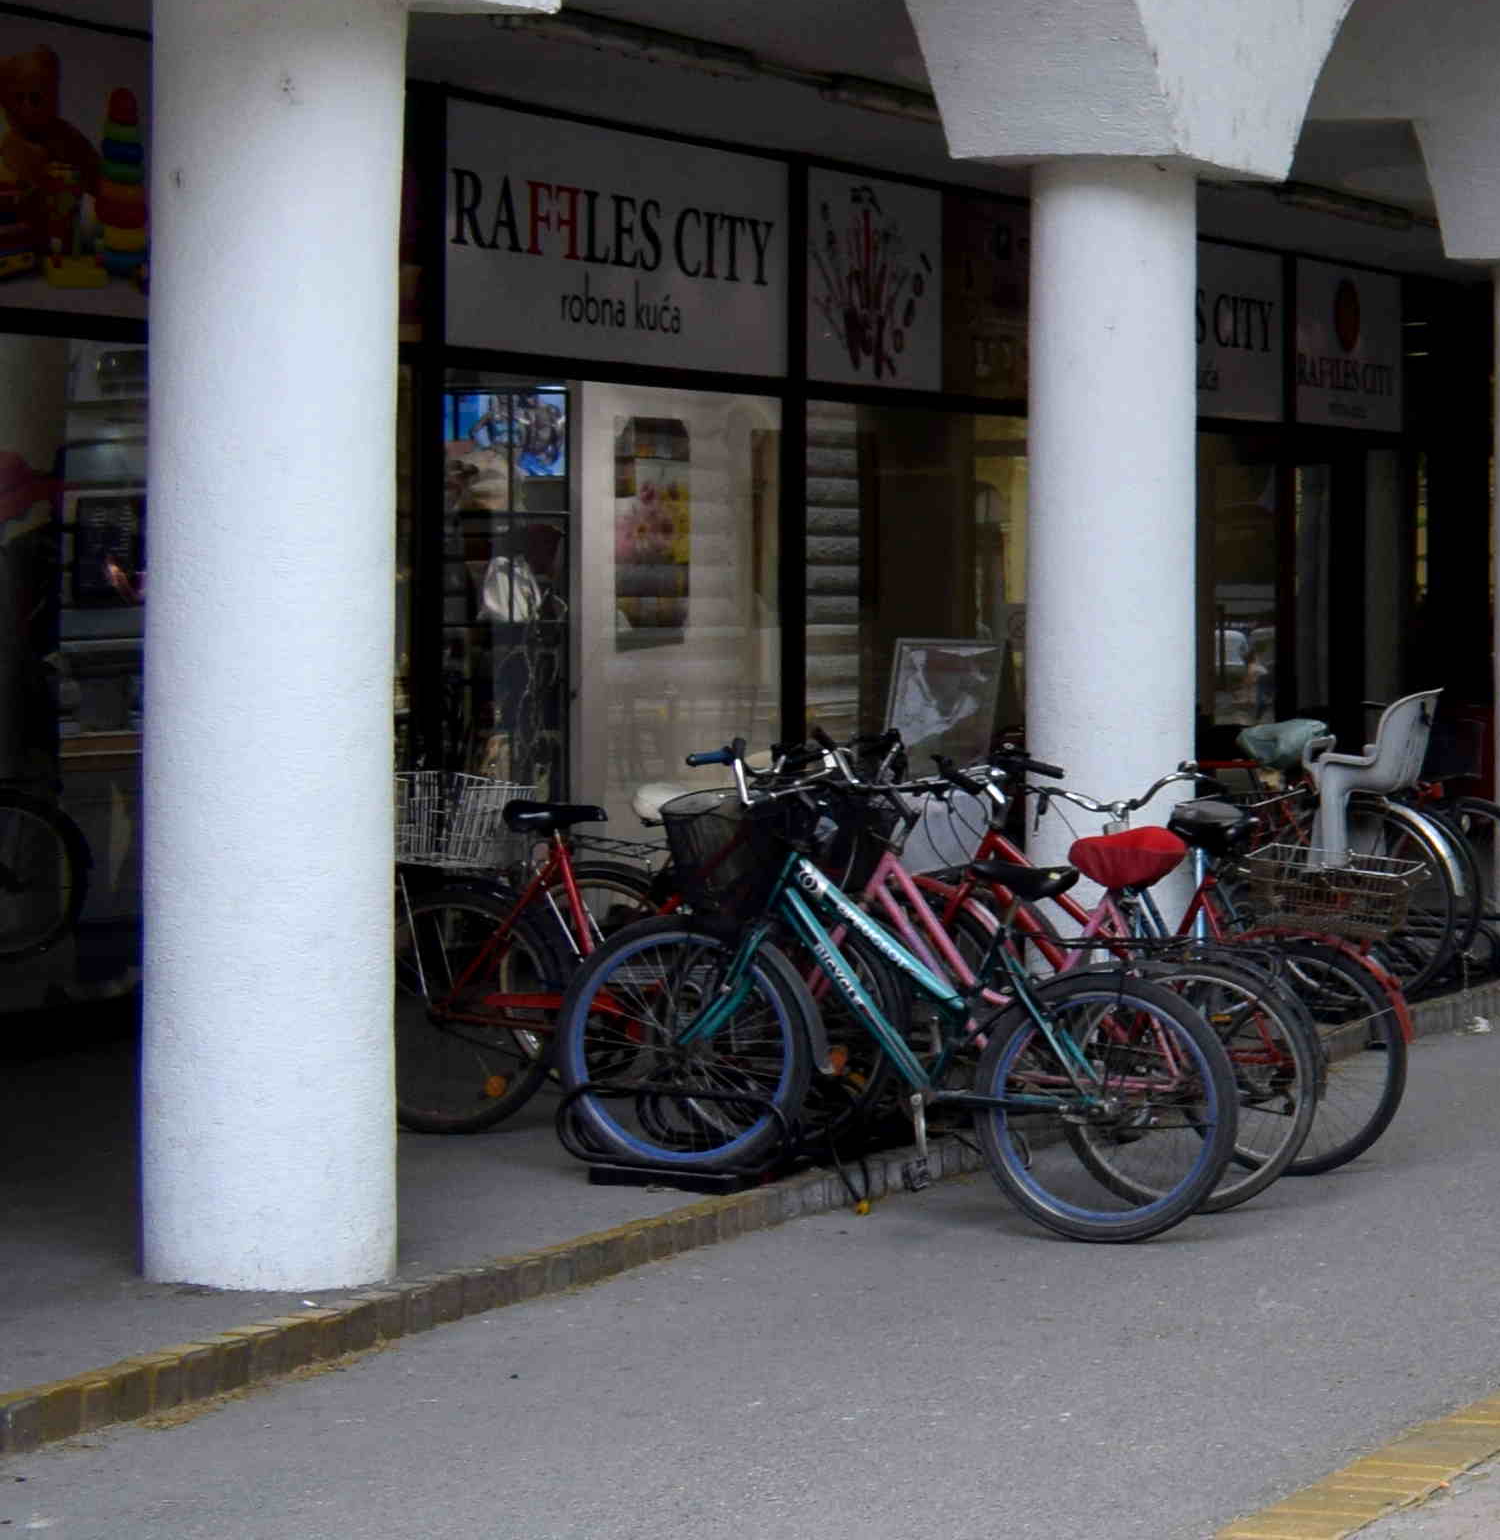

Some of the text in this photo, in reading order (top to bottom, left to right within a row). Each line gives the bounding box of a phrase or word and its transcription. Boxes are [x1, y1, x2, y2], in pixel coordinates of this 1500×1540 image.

[451, 167, 774, 286] RAFFLES CITY
[560, 269, 681, 334] robna kuća
[1214, 293, 1274, 353] CITY
